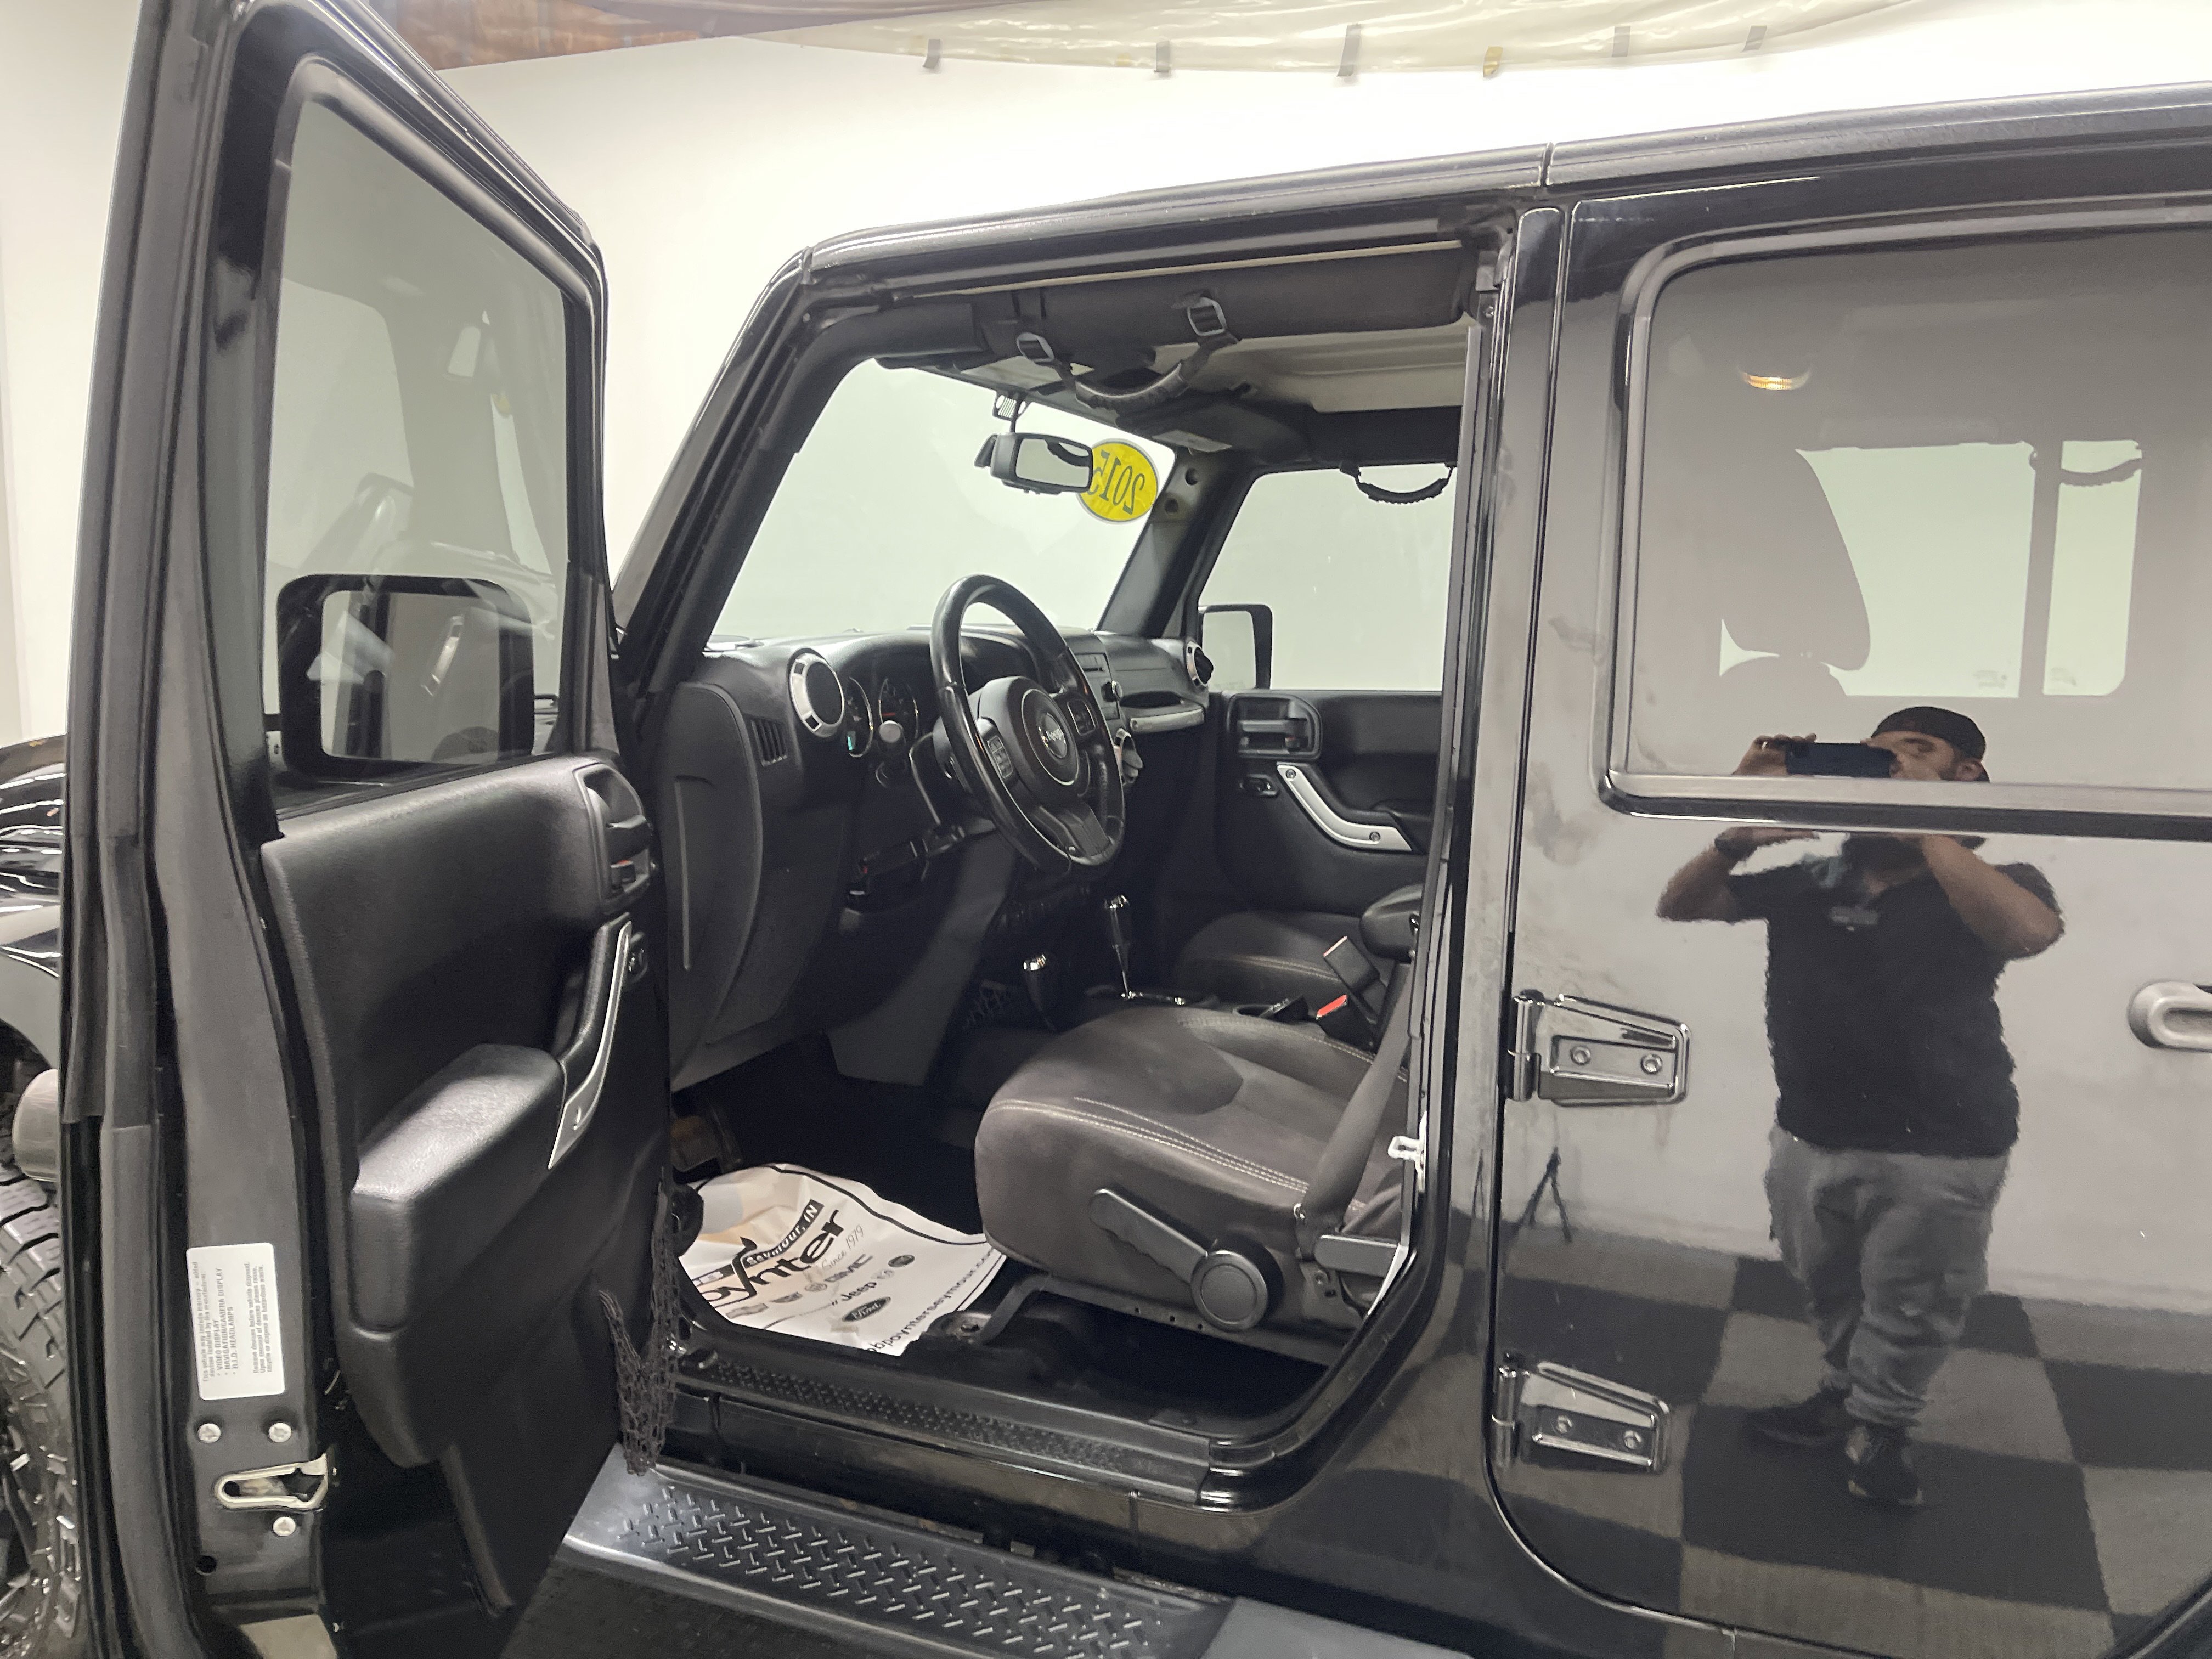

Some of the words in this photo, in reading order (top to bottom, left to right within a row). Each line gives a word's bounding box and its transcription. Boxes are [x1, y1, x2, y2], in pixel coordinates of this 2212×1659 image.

[803, 1204, 819, 1223] IN
[845, 1224, 864, 1250] 1979
[215, 1267, 224, 1296] DISPLAY
[840, 1282, 877, 1301] Jeep
[212, 1319, 221, 1347] DISPLAY
[226, 1306, 236, 1348] HEADLAMPS
[215, 1350, 223, 1370] VIDEO
